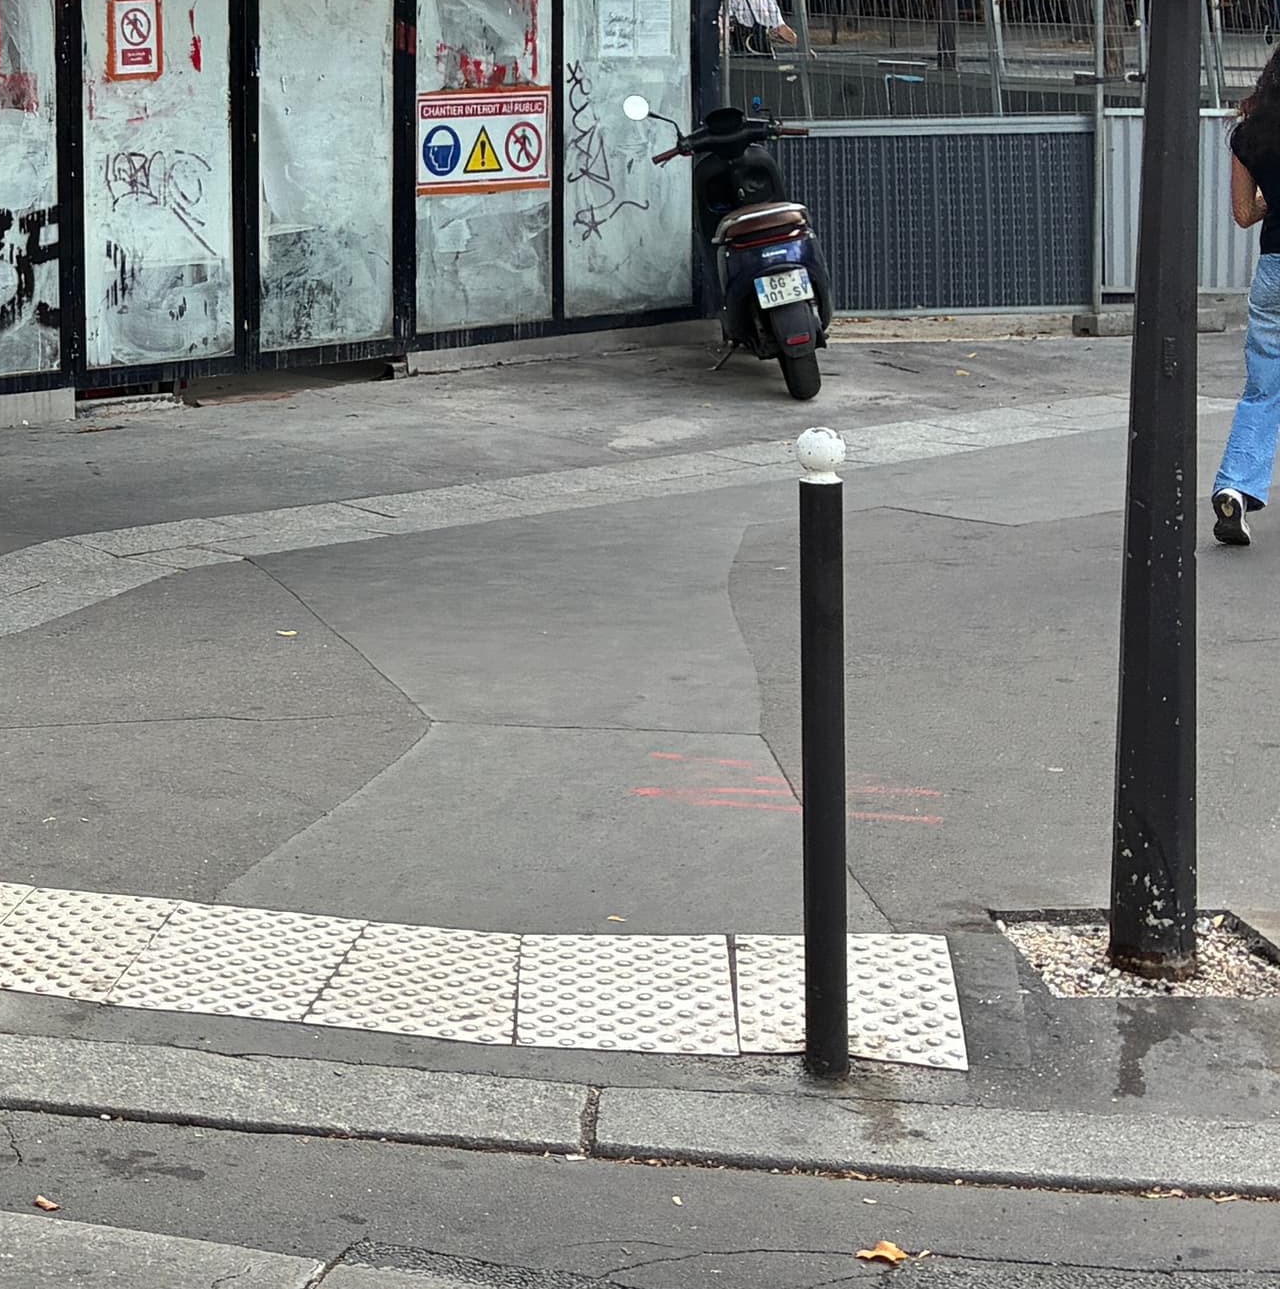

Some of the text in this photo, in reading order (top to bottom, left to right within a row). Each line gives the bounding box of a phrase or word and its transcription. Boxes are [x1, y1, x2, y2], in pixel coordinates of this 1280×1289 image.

[423, 101, 542, 117] CHANTIER INTERDIT AU PUBLIC
